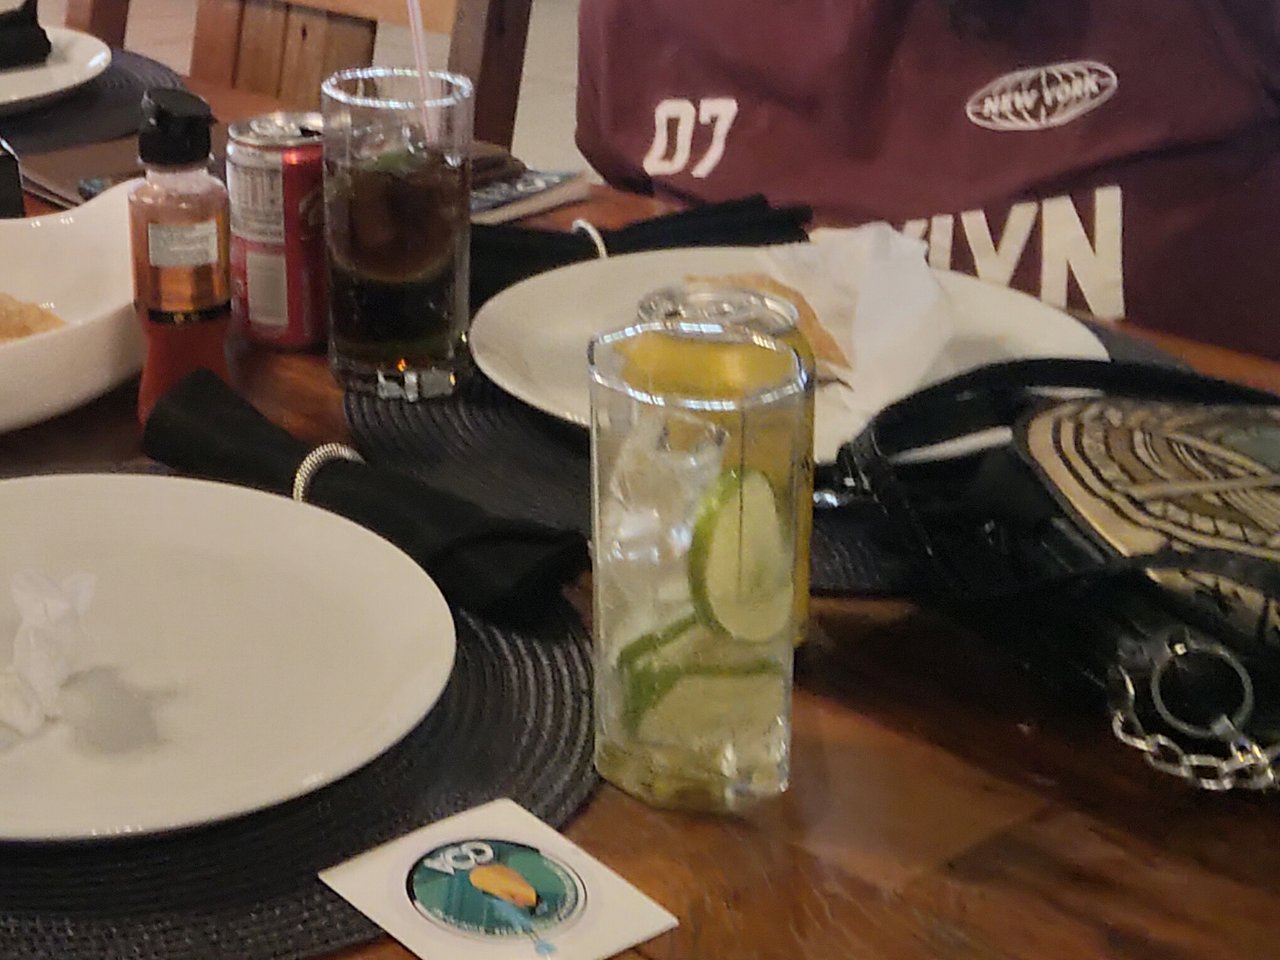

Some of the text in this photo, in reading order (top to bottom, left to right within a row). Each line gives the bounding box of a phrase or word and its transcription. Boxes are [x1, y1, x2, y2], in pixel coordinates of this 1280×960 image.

[983, 74, 1101, 119] NEW YORK
[642, 98, 739, 178] 07
